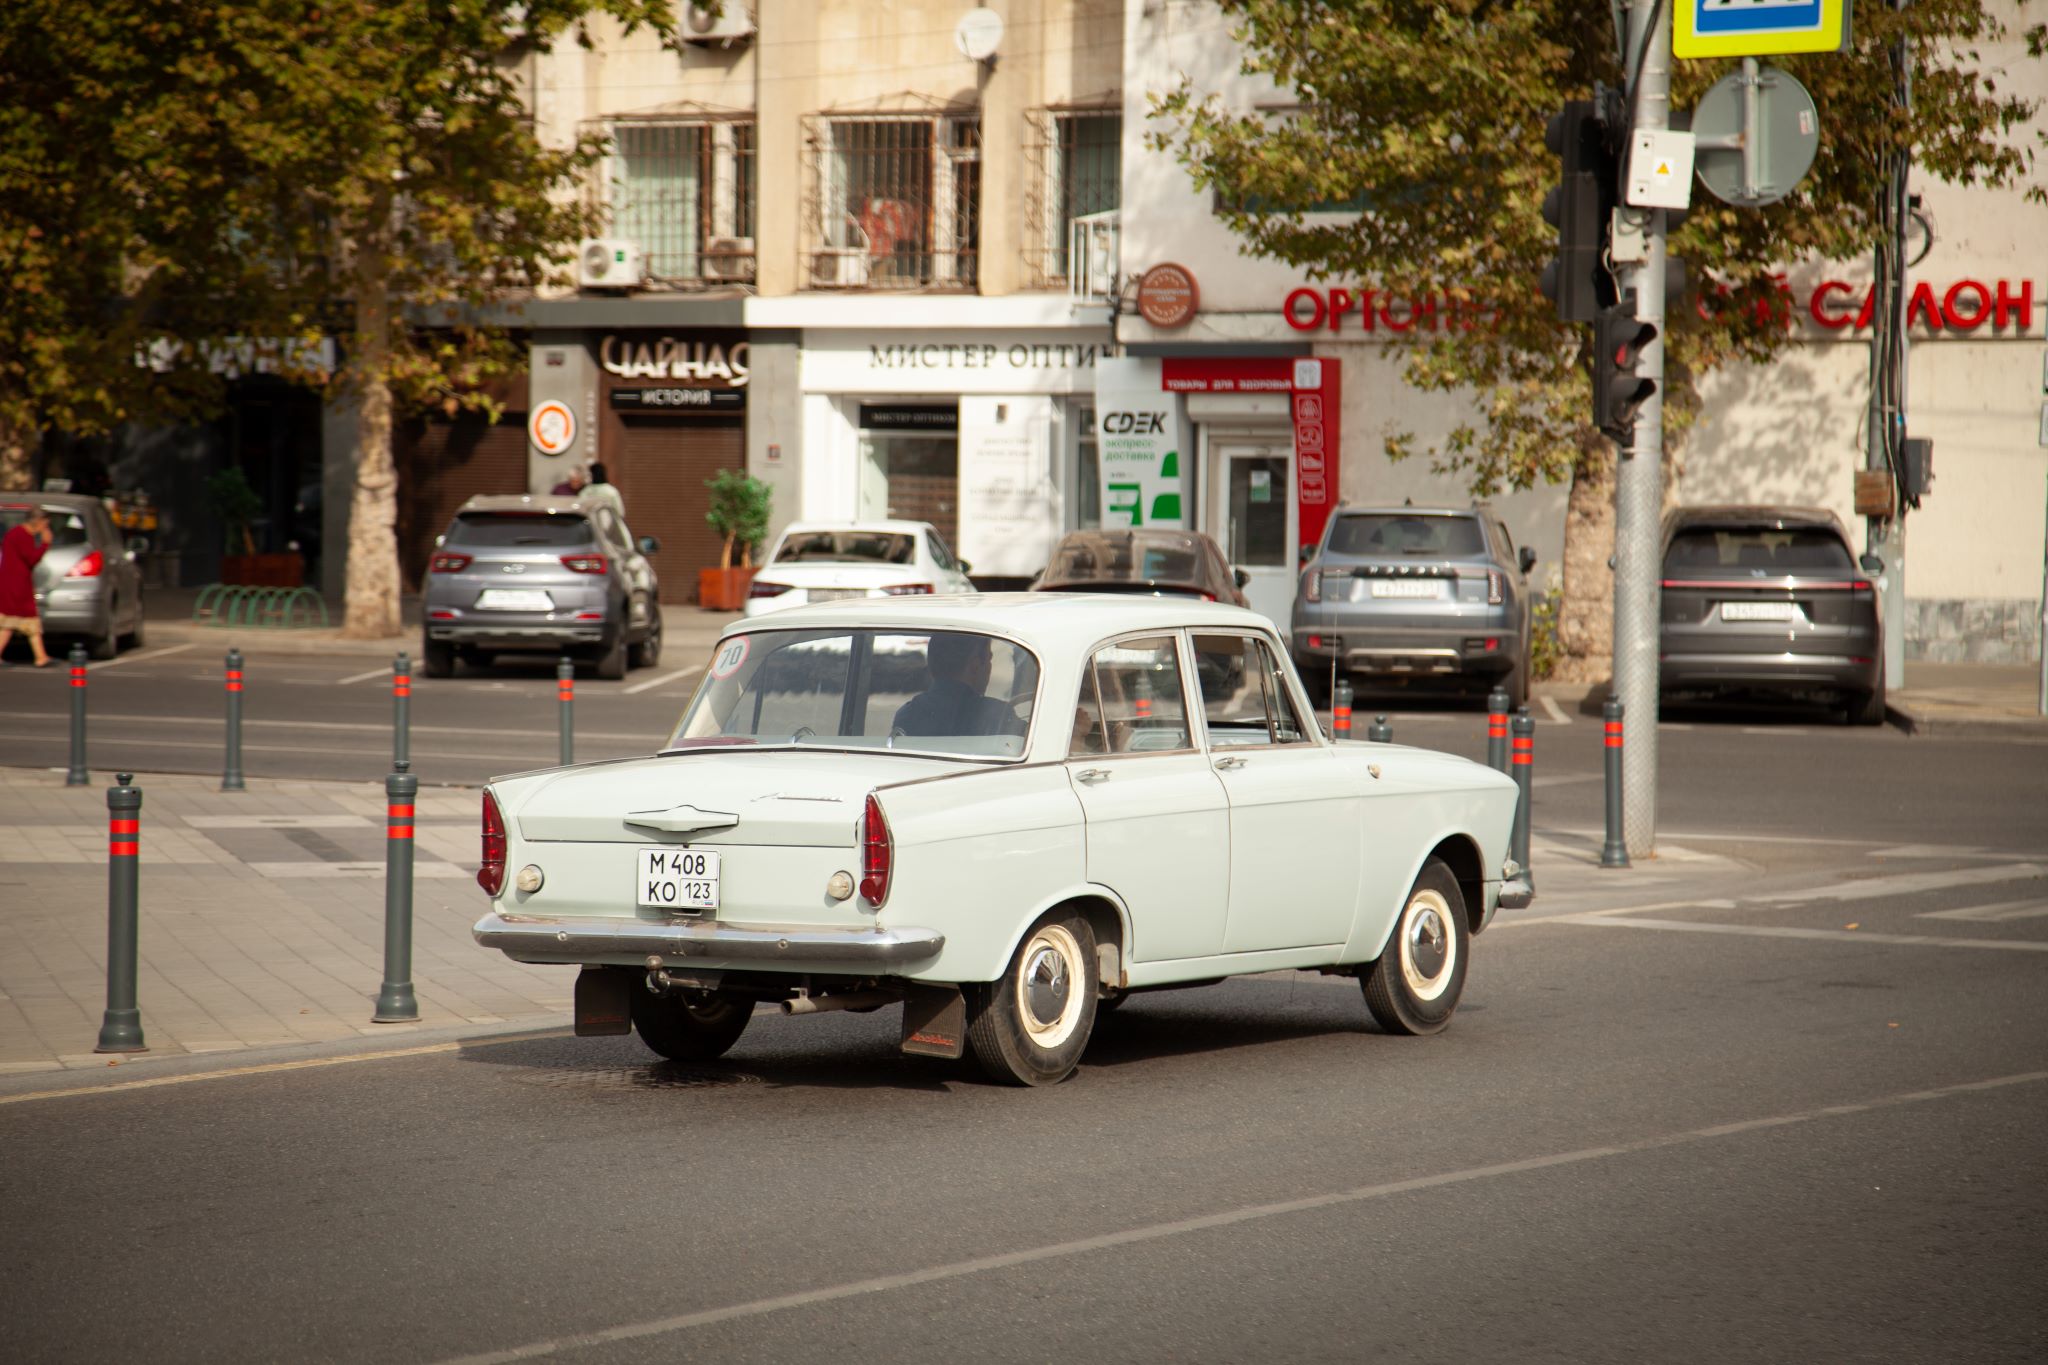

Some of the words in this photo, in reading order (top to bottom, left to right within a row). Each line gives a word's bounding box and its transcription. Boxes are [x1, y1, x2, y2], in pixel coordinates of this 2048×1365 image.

[869, 344, 997, 368] МИСТЕР
[1167, 379, 1207, 390] ТОВАРЫ
[1213, 379, 1234, 390] ДЛЯ
[1239, 379, 1292, 390] ЗДОРОВЬЯ
[641, 389, 711, 405] ИСТОРИЯ
[1103, 411, 1168, 434] CDEK
[1105, 450, 1155, 461] доставка
[720, 645, 744, 669] 70
[671, 853, 705, 875] 408
[684, 882, 711, 899] 123
